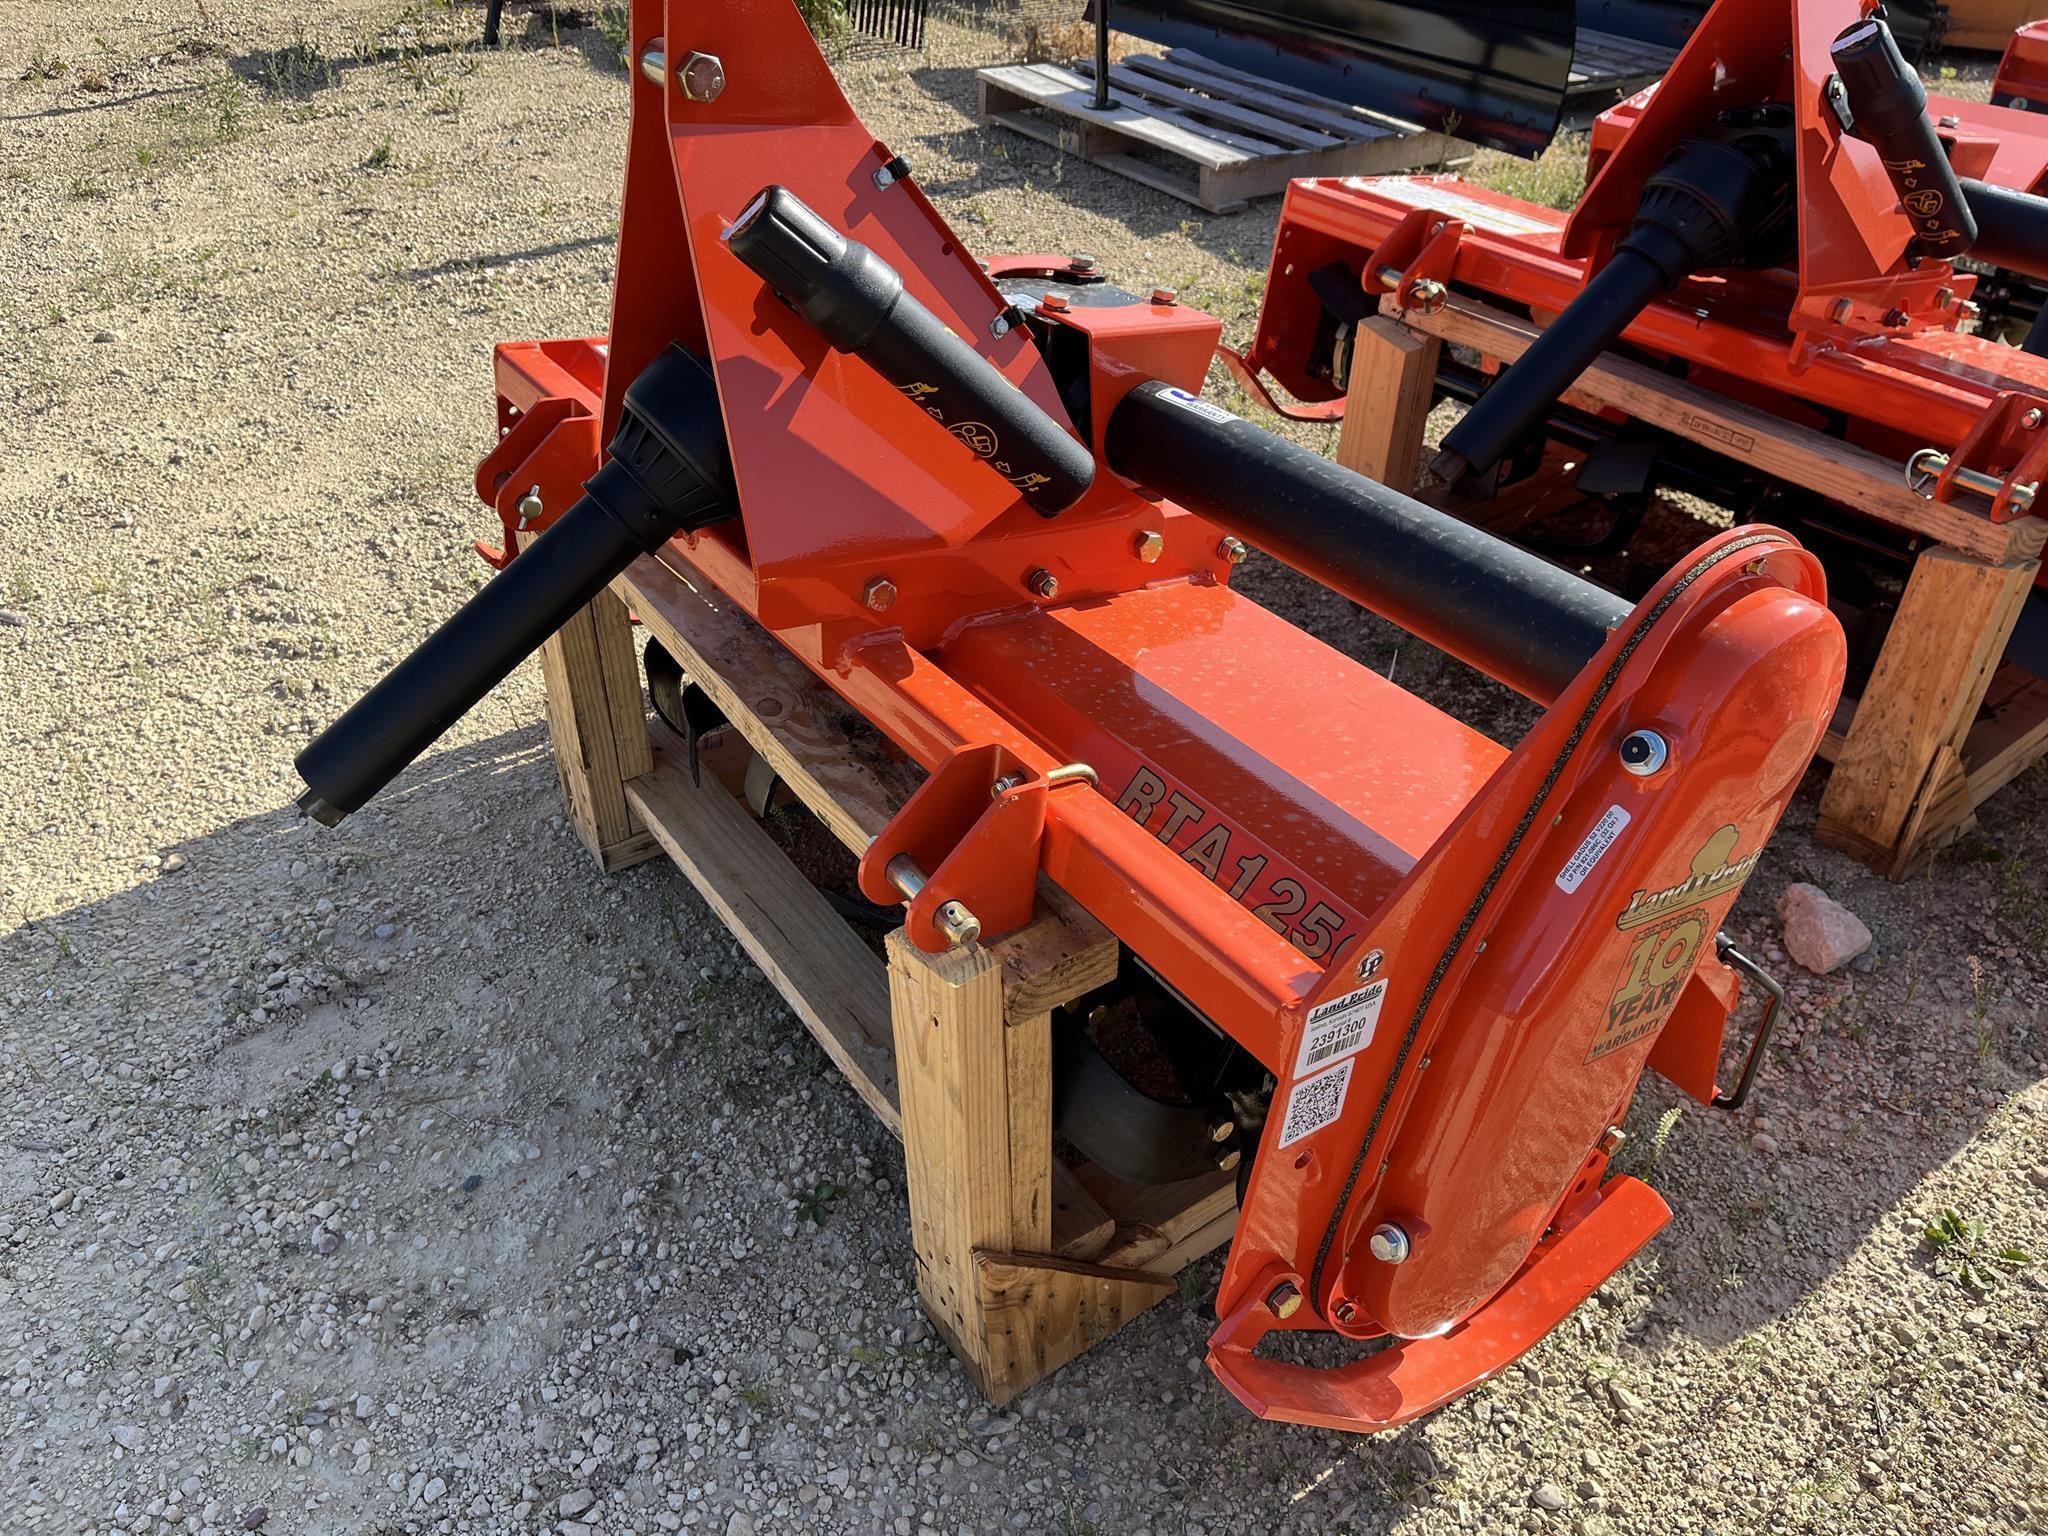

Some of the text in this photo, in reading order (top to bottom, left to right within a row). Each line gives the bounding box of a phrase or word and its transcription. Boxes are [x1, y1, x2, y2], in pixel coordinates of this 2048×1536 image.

[1115, 765, 1357, 967] RTA125
[1560, 861, 1576, 879] SHELL
[1574, 840, 1591, 861] GADUS
[1580, 831, 1616, 877] OR EQUIVALENT
[1566, 872, 1574, 882] LP
[1622, 873, 1698, 921] Land
[1612, 918, 1701, 1006] 10
[1310, 984, 1383, 1021] Land Pride
[1310, 1017, 1366, 1050] 2391300
[1592, 1016, 1661, 1057] WARRANTY
